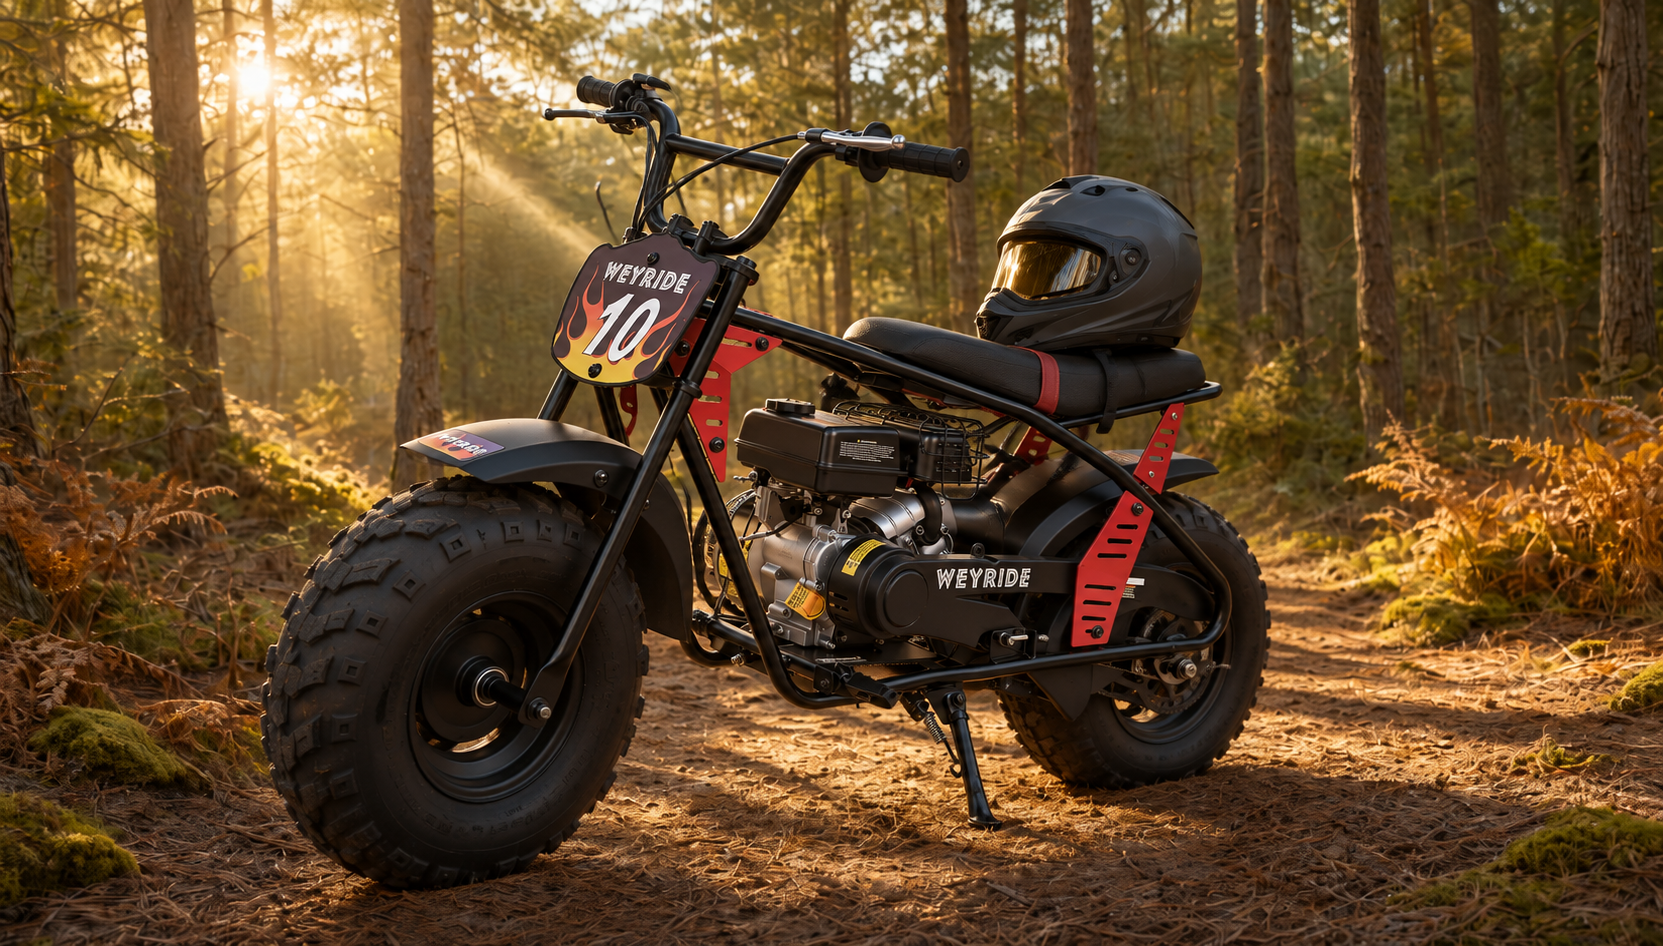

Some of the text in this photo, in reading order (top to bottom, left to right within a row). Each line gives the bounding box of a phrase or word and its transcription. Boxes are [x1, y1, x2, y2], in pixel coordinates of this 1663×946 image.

[603, 261, 692, 295] WEYRIDE
[582, 293, 661, 362] 10
[936, 567, 1032, 590] WEYRIDE
